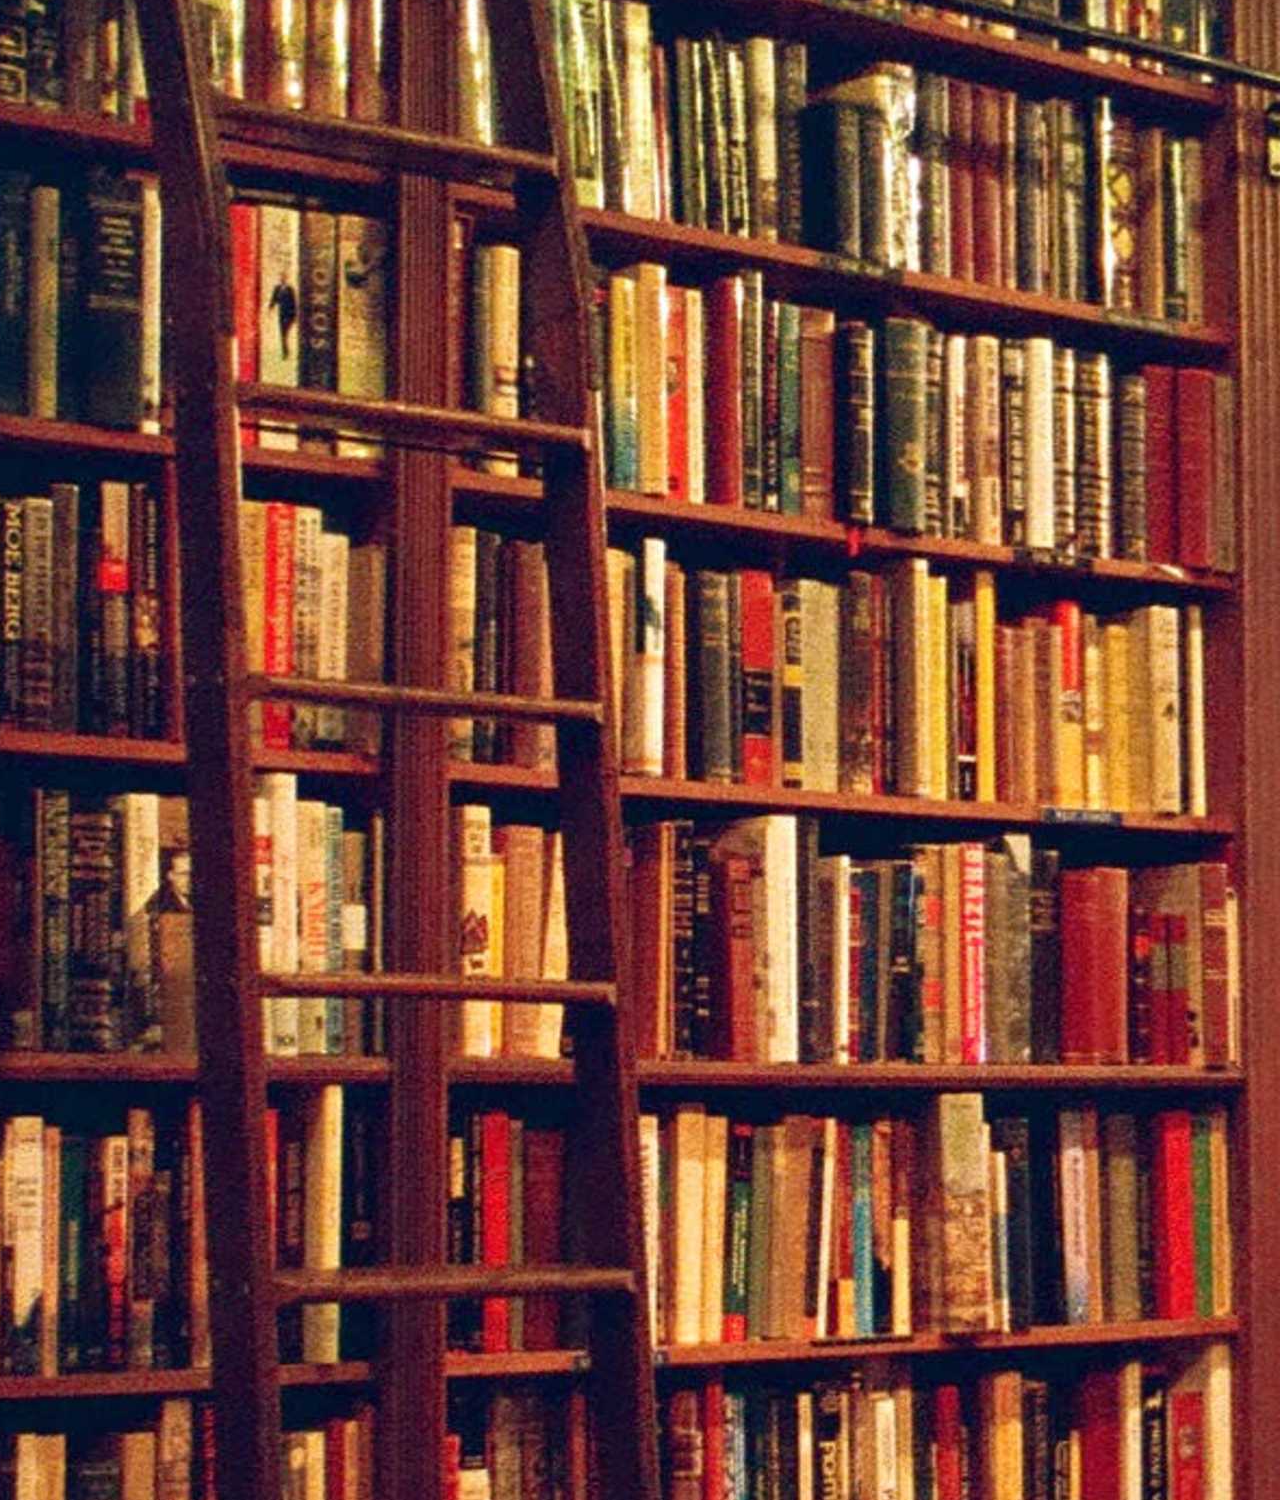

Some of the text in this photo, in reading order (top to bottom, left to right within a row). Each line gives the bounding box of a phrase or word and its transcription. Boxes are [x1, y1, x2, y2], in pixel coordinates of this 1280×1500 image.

[3, 502, 23, 641] MOE BERG
[964, 849, 984, 944] BRAZIL
